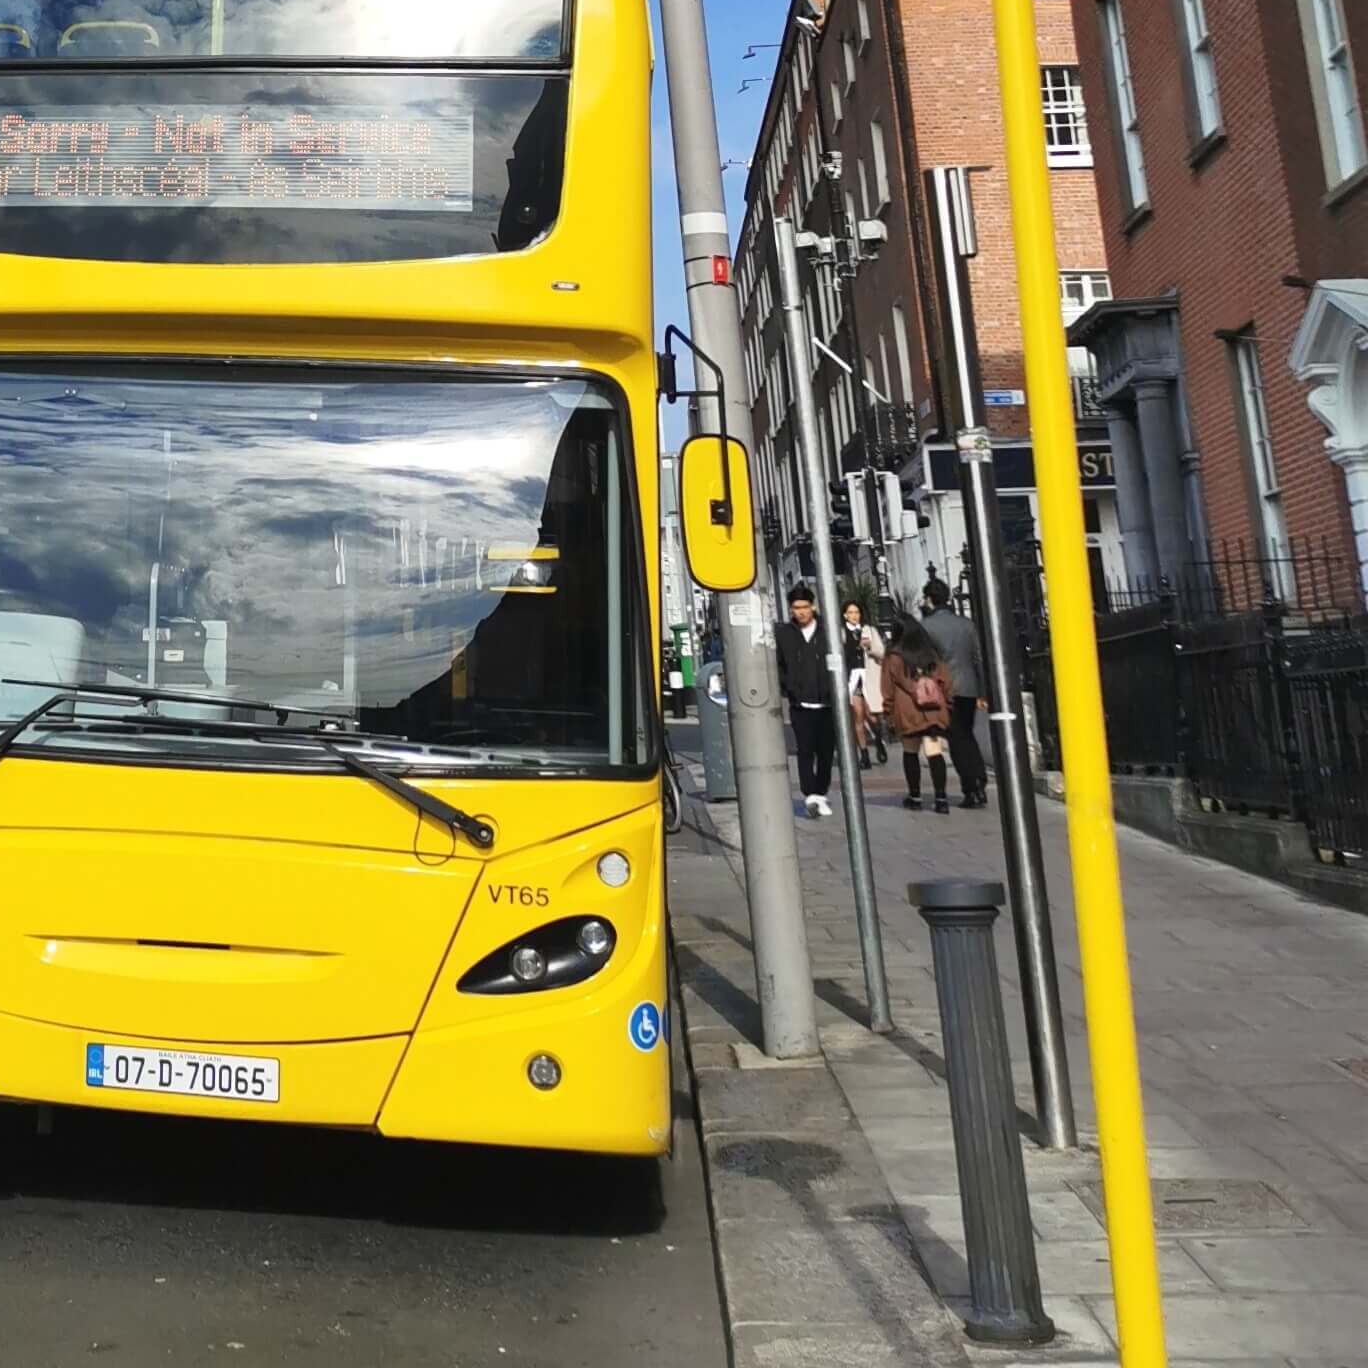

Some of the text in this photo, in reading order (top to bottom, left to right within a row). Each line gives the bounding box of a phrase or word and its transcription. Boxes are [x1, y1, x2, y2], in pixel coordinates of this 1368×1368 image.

[0, 114, 109, 153] Sorry
[155, 114, 224, 153] Not
[289, 114, 431, 153] Service
[488, 884, 550, 907] VT65
[115, 1056, 265, 1096] 07-D-70065
